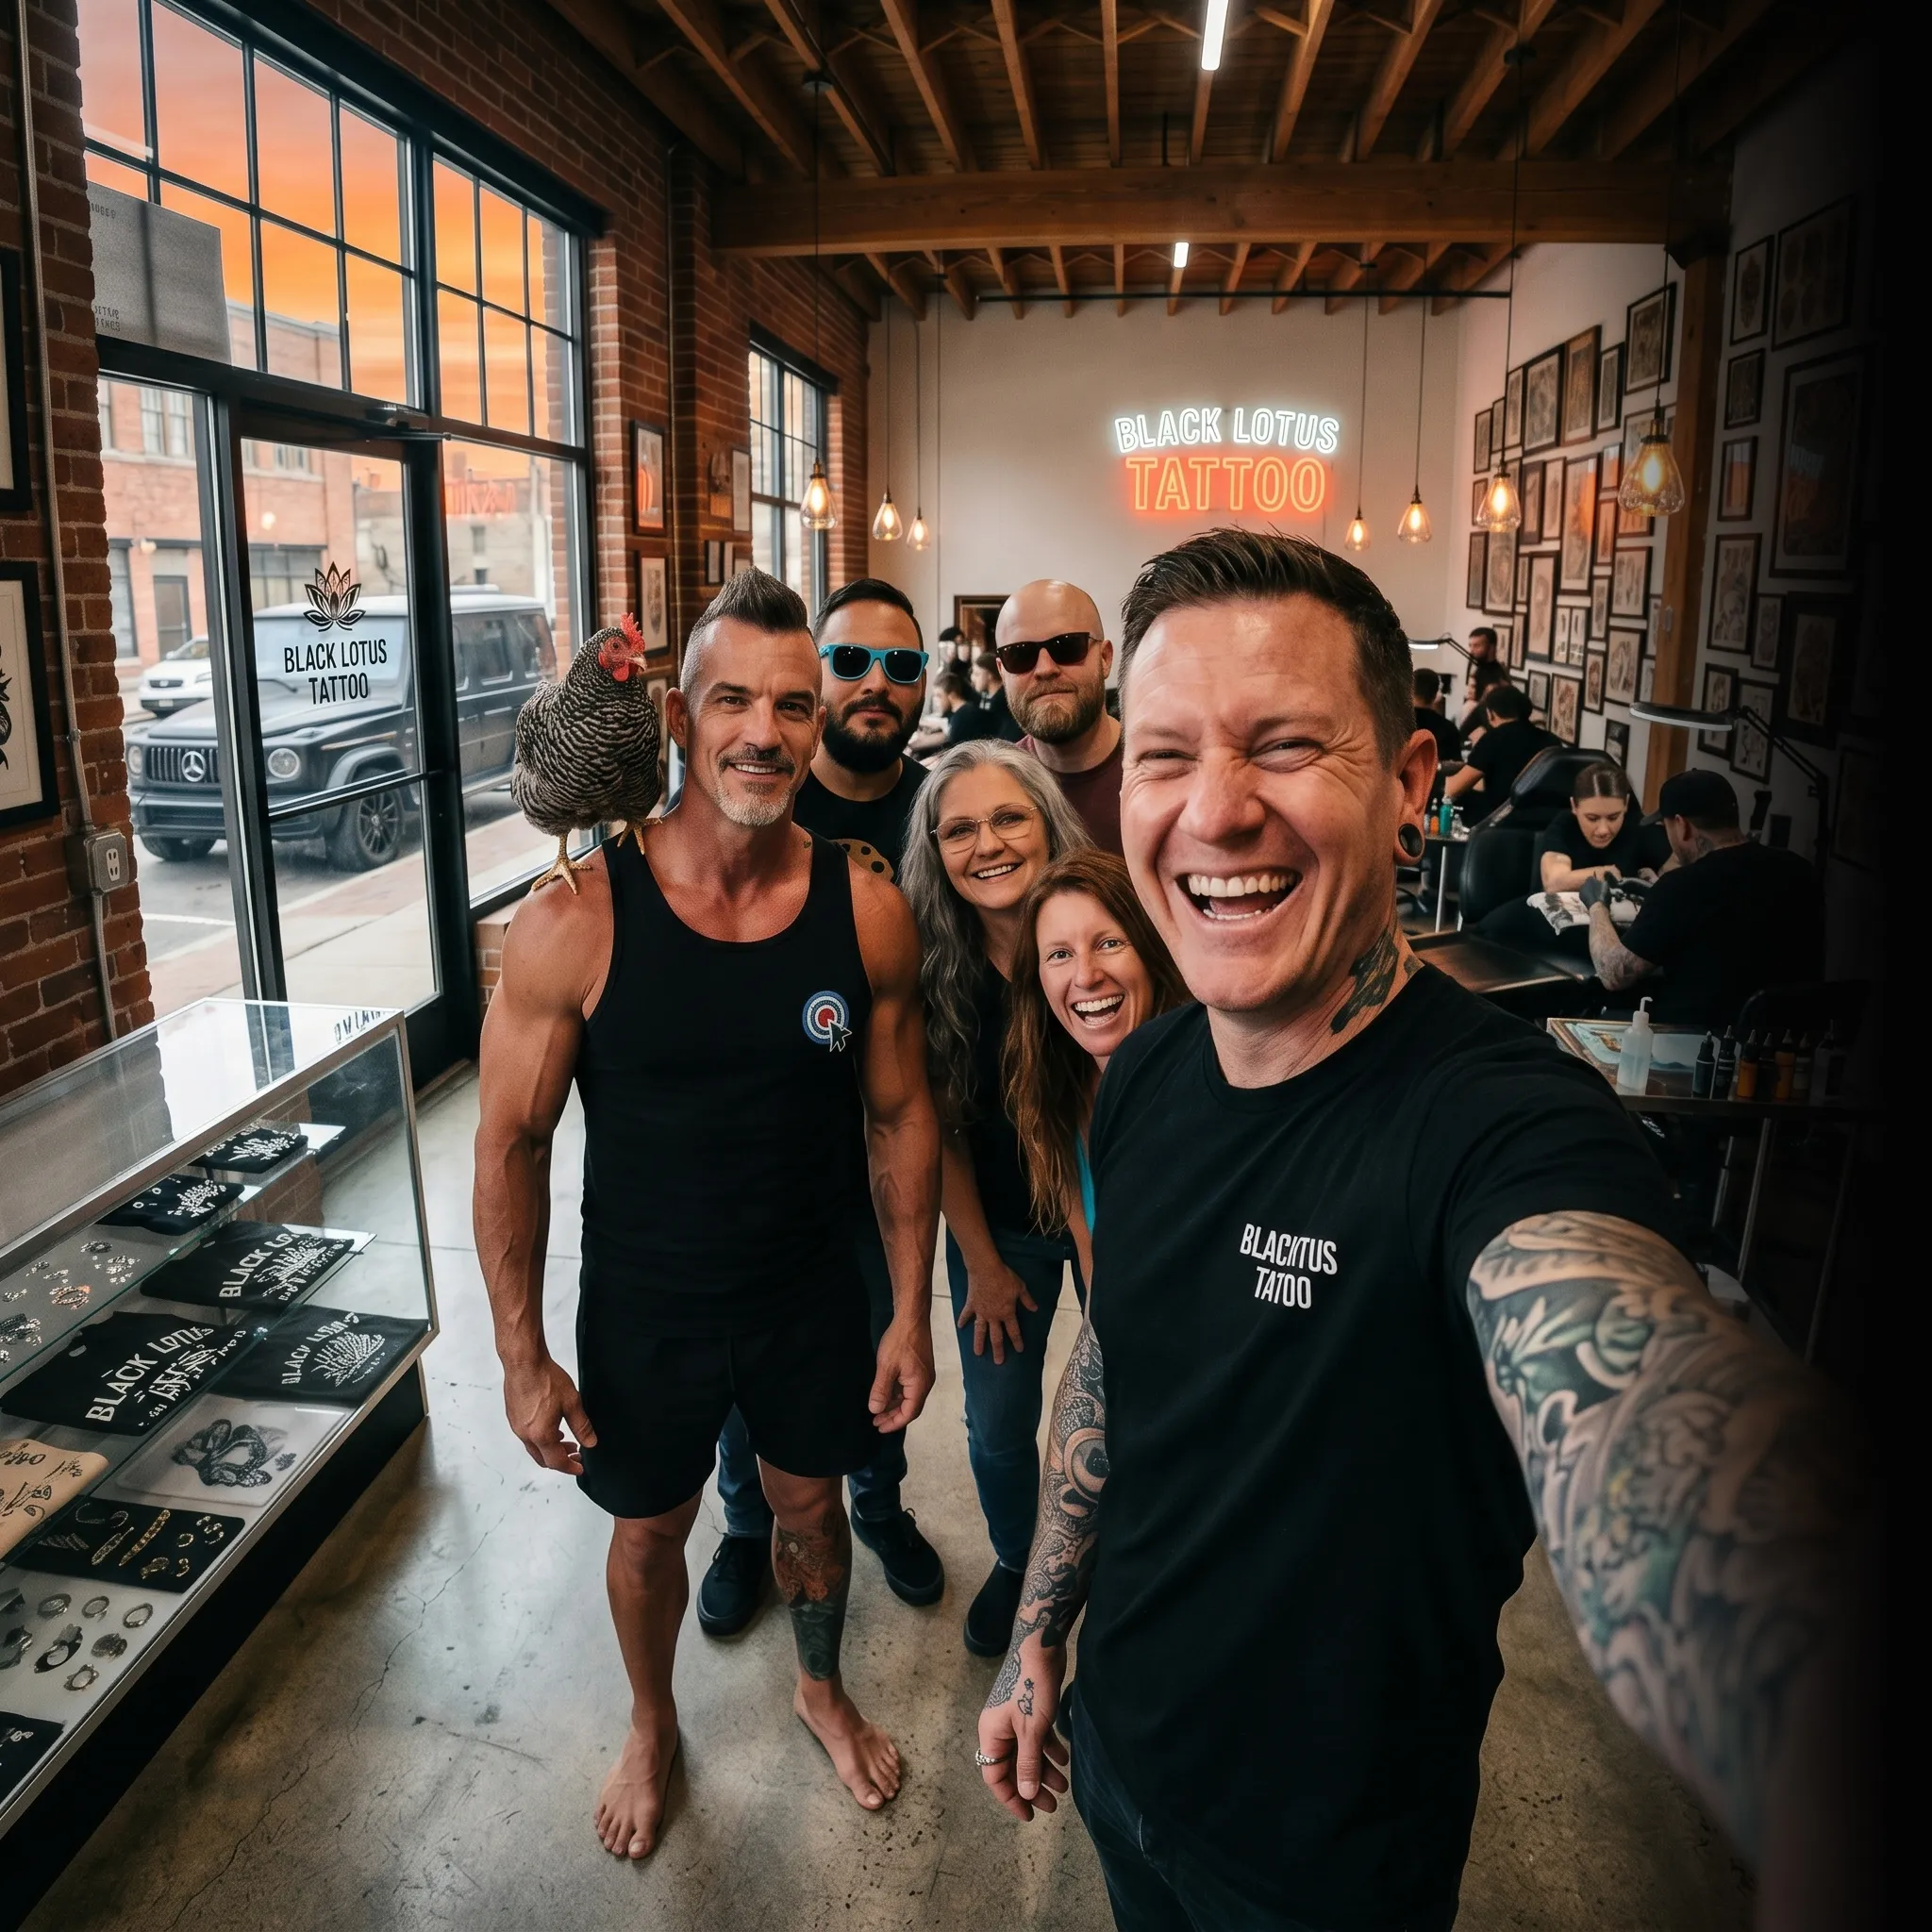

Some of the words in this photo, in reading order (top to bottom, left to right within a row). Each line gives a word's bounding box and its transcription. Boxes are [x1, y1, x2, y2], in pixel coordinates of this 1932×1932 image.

[1115, 408, 1222, 453] BLACK
[1233, 408, 1339, 454] LOTUS
[1125, 457, 1324, 512] TATTOO
[284, 642, 337, 673] BLACK
[341, 639, 387, 667] LOTUS
[308, 673, 369, 705] TATTOO
[219, 1248, 274, 1297] BLACK
[1255, 1266, 1311, 1308] TATOO
[85, 1354, 158, 1422] BLACK
